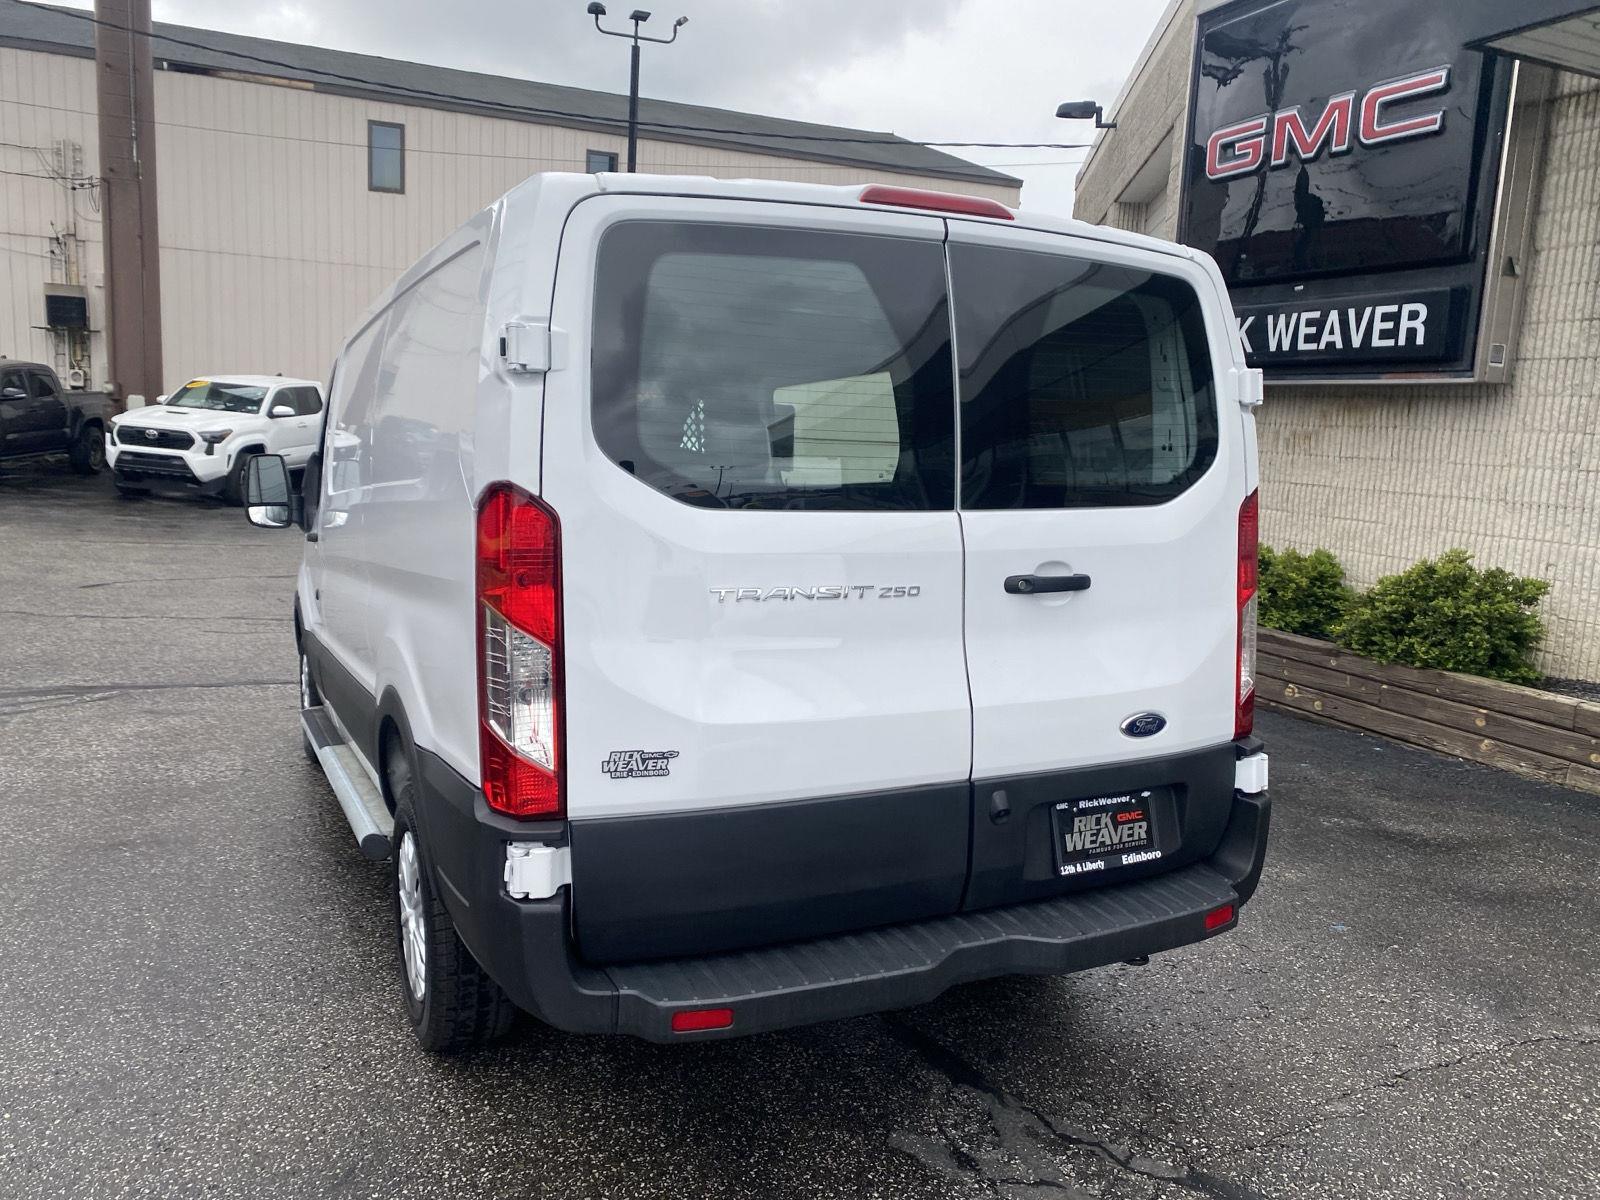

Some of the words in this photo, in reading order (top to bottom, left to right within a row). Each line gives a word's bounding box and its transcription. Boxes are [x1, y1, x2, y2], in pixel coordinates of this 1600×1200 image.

[1206, 66, 1449, 180] GMC
[1267, 303, 1428, 352] WEAVER
[710, 585, 874, 602] TRANSIT
[878, 586, 920, 599] 250
[1134, 718, 1158, 733] Ford
[609, 750, 643, 762] RICK
[602, 759, 668, 773] WEAVER
[632, 769, 669, 777] EDINBORO
[1079, 796, 1130, 809] RickWeaver
[1073, 812, 1112, 833] RICK
[1117, 811, 1143, 822] GMC
[1065, 821, 1147, 853] WEAVER
[1121, 850, 1162, 865] Edinboro
[1061, 864, 1076, 875] 12th
[1076, 863, 1083, 873] &
[1083, 860, 1105, 872] Liberty
